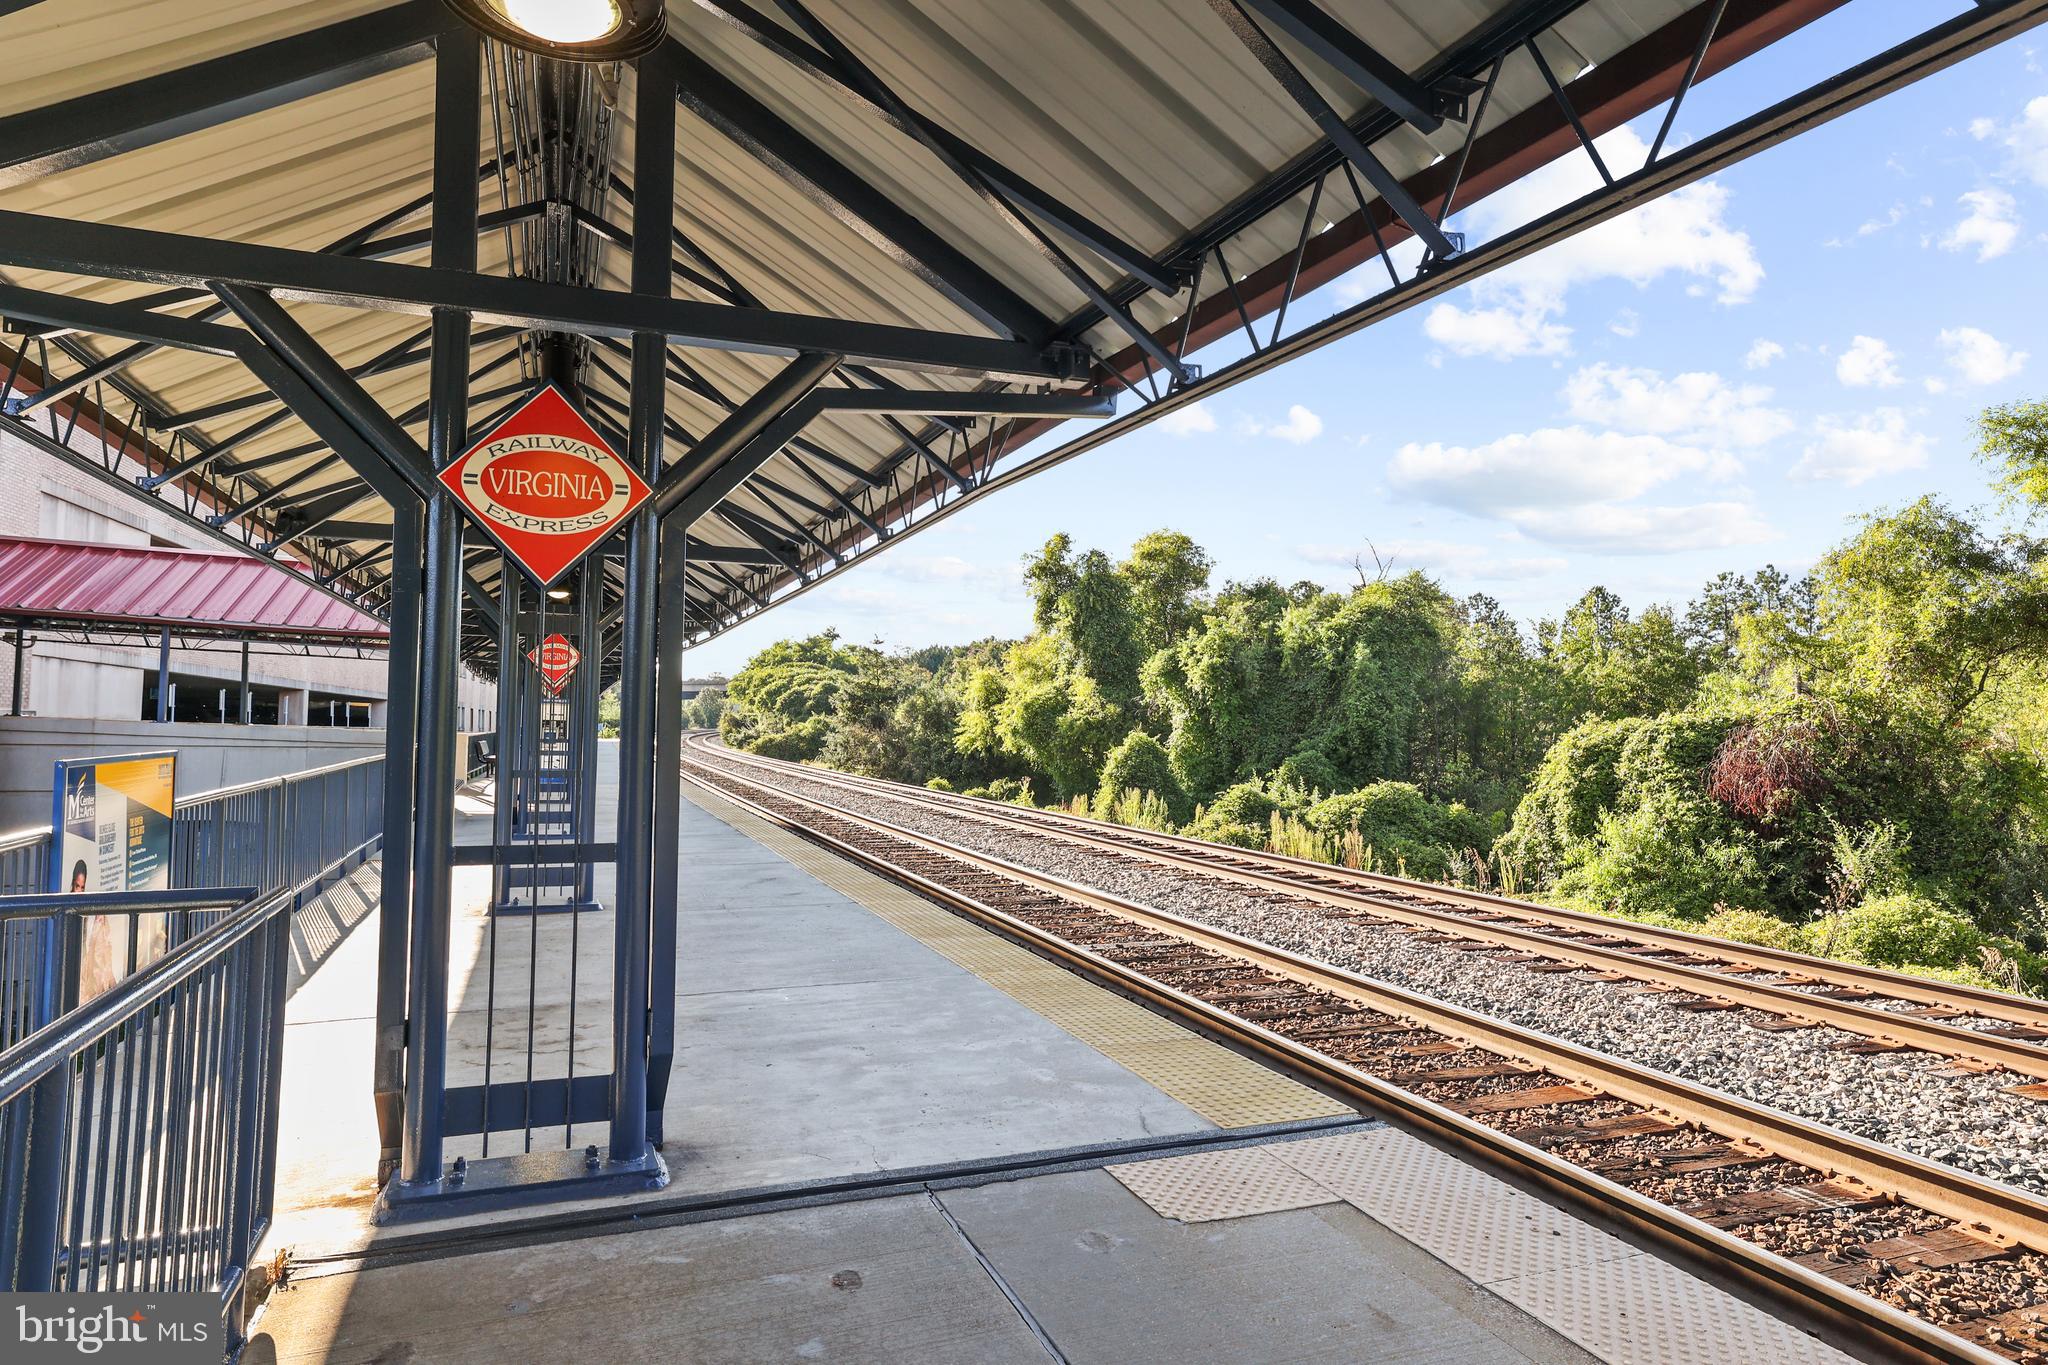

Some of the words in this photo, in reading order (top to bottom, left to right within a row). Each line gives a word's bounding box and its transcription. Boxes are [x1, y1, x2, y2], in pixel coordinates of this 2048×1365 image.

[486, 437, 608, 464] RAILWAY
[488, 467, 606, 501] VIRGINIA
[485, 502, 609, 532] EXPRESS
[80, 795, 95, 806] Center
[84, 805, 95, 817] Arts
